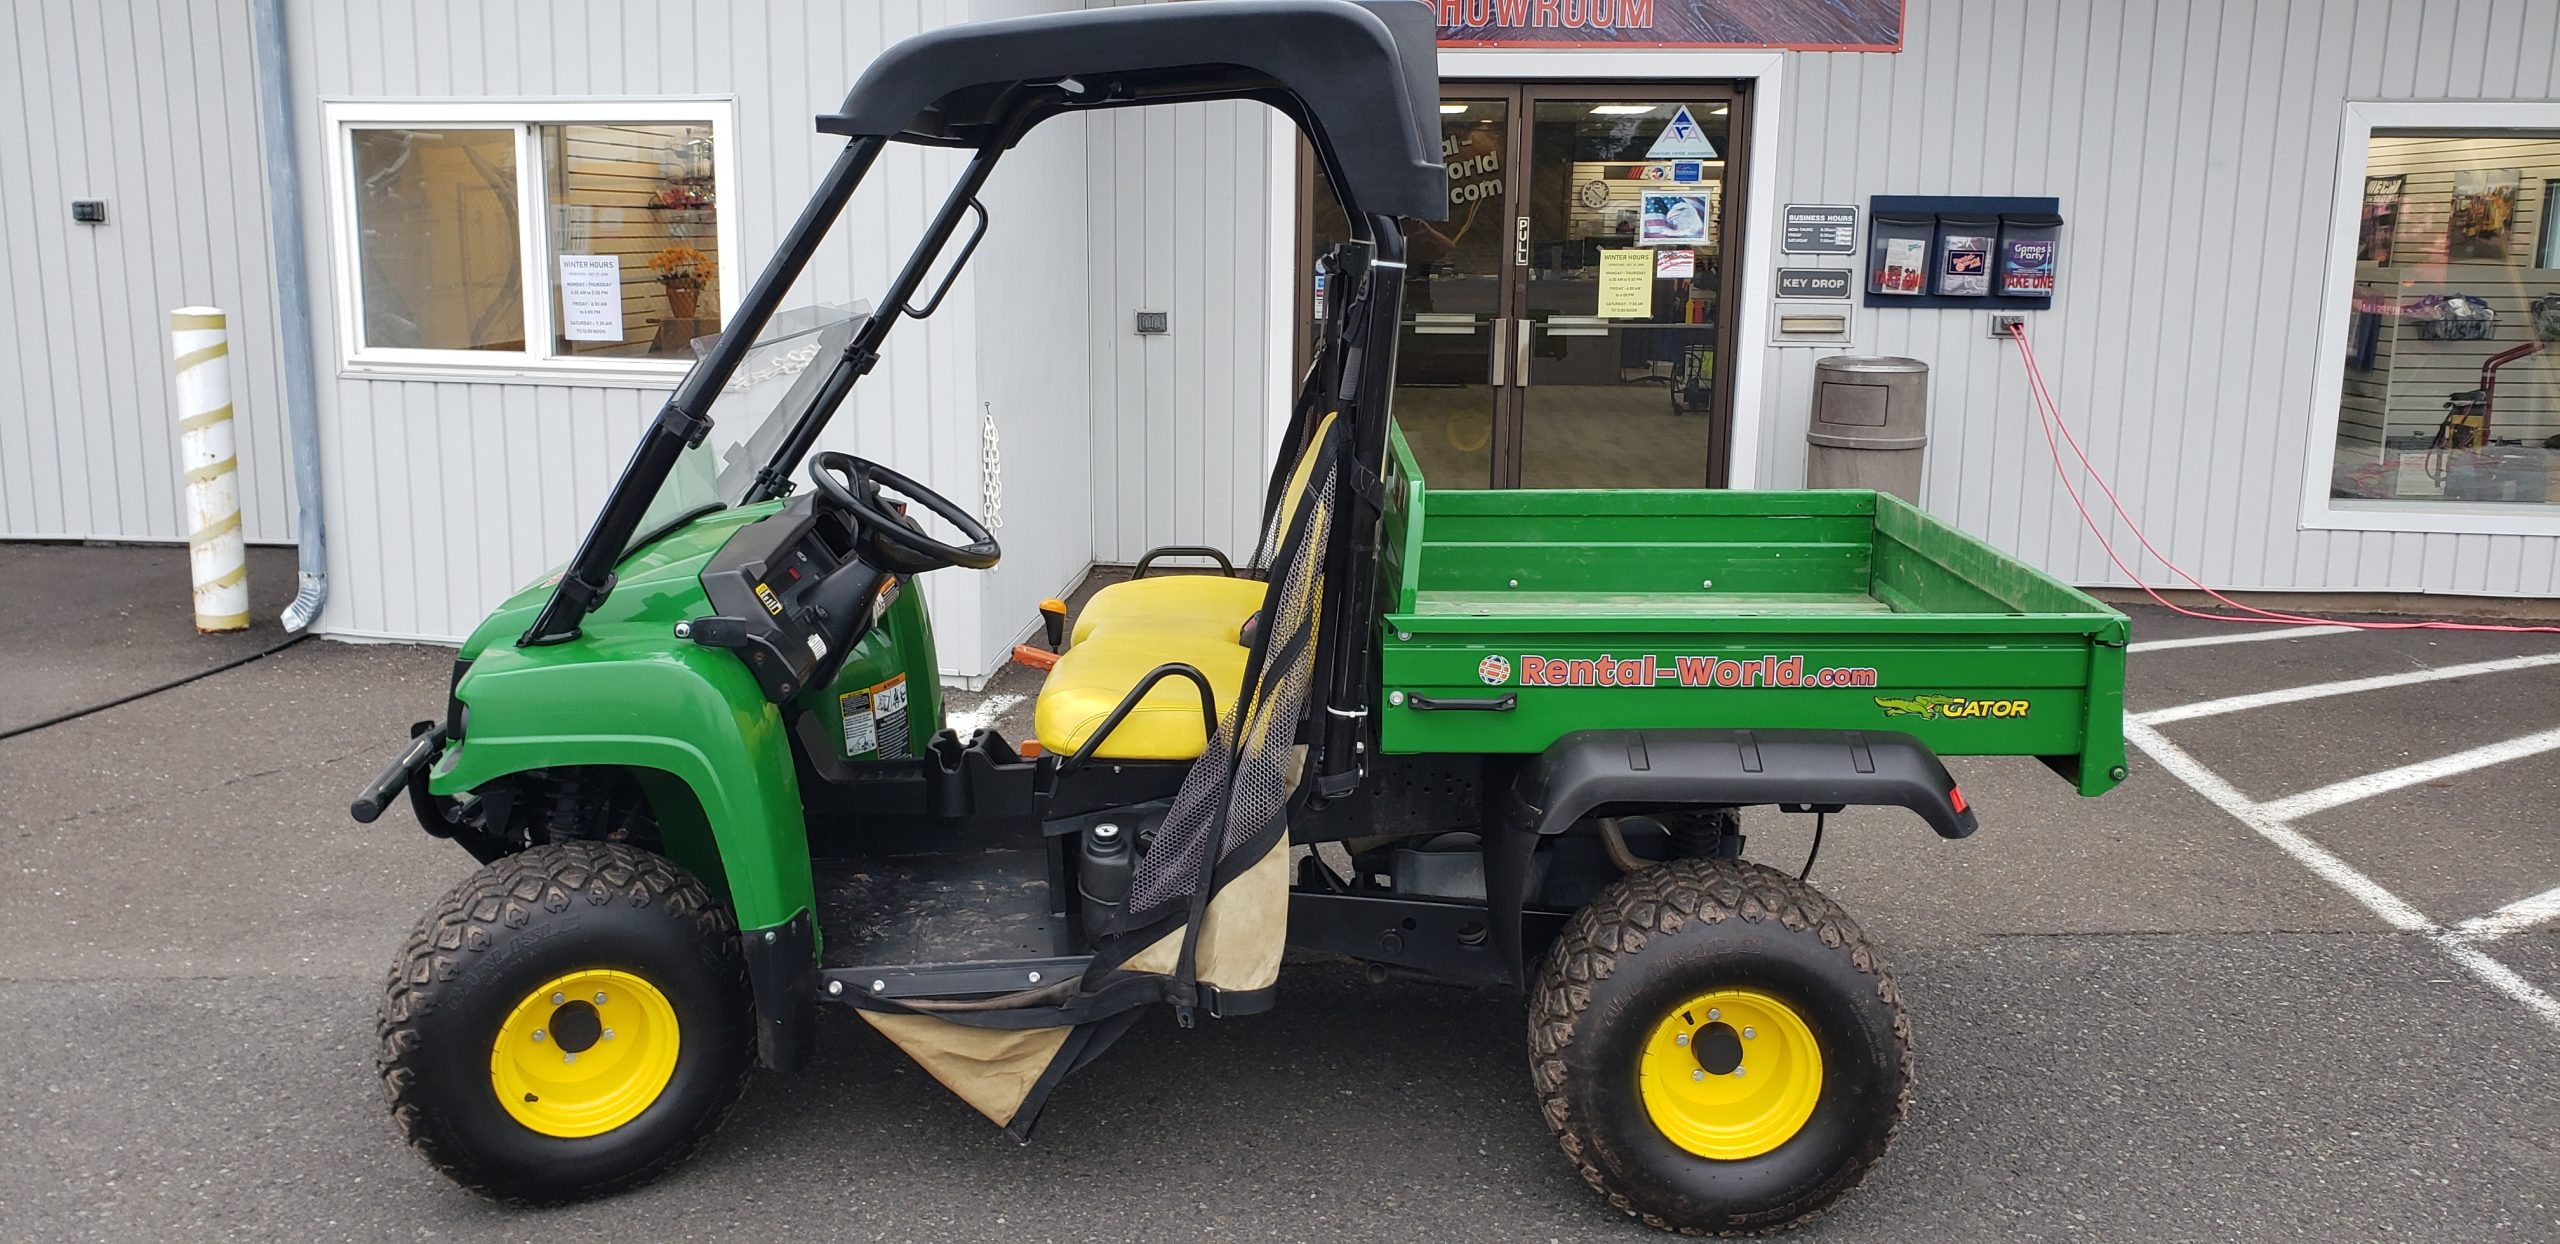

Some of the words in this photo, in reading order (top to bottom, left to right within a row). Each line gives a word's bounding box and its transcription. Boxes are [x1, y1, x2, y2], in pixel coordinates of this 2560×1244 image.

[1518, 219, 1528, 263] PULL
[2015, 243, 2046, 253] Games
[2020, 251, 2045, 261] Party
[589, 261, 614, 269] HOURS
[1783, 278, 1808, 288] KEY
[1811, 279, 1845, 289] DROP
[2002, 273, 2029, 289] TAKE
[2032, 274, 2054, 289] ONE
[1519, 653, 1878, 688] Rental-World.com
[1942, 697, 2031, 718] GATOR
